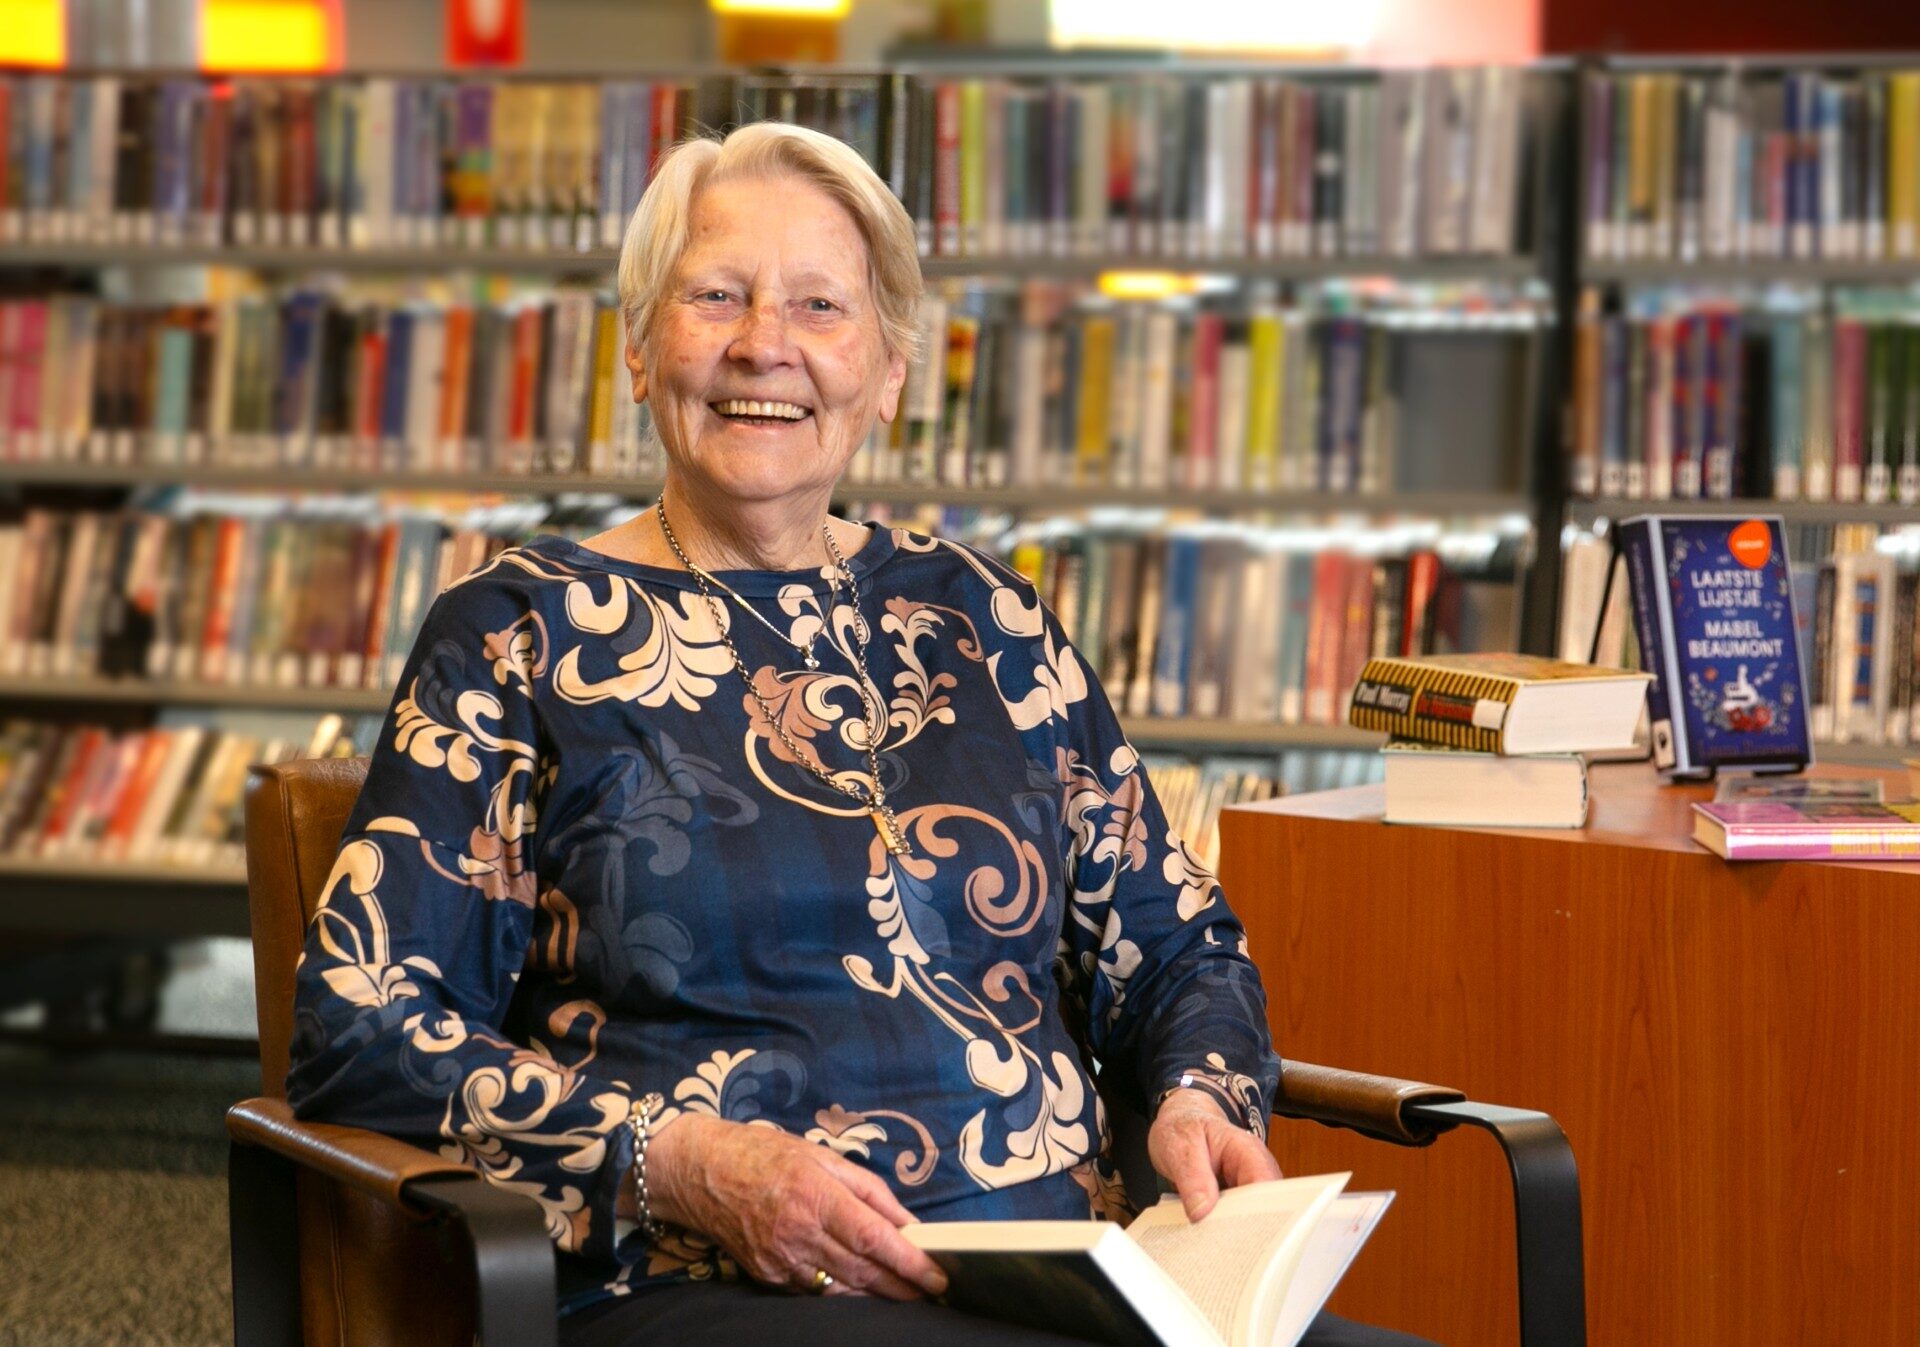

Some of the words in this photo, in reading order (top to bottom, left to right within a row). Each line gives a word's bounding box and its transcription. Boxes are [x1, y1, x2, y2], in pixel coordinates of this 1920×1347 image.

[1691, 570, 1764, 589] LAATSTE
[1698, 589, 1762, 608] LIJSTJE
[1704, 620, 1764, 638] MABEL
[1688, 639, 1783, 658] BEAUMONT
[1355, 682, 1380, 705] Paul
[1377, 685, 1412, 713] Murray
